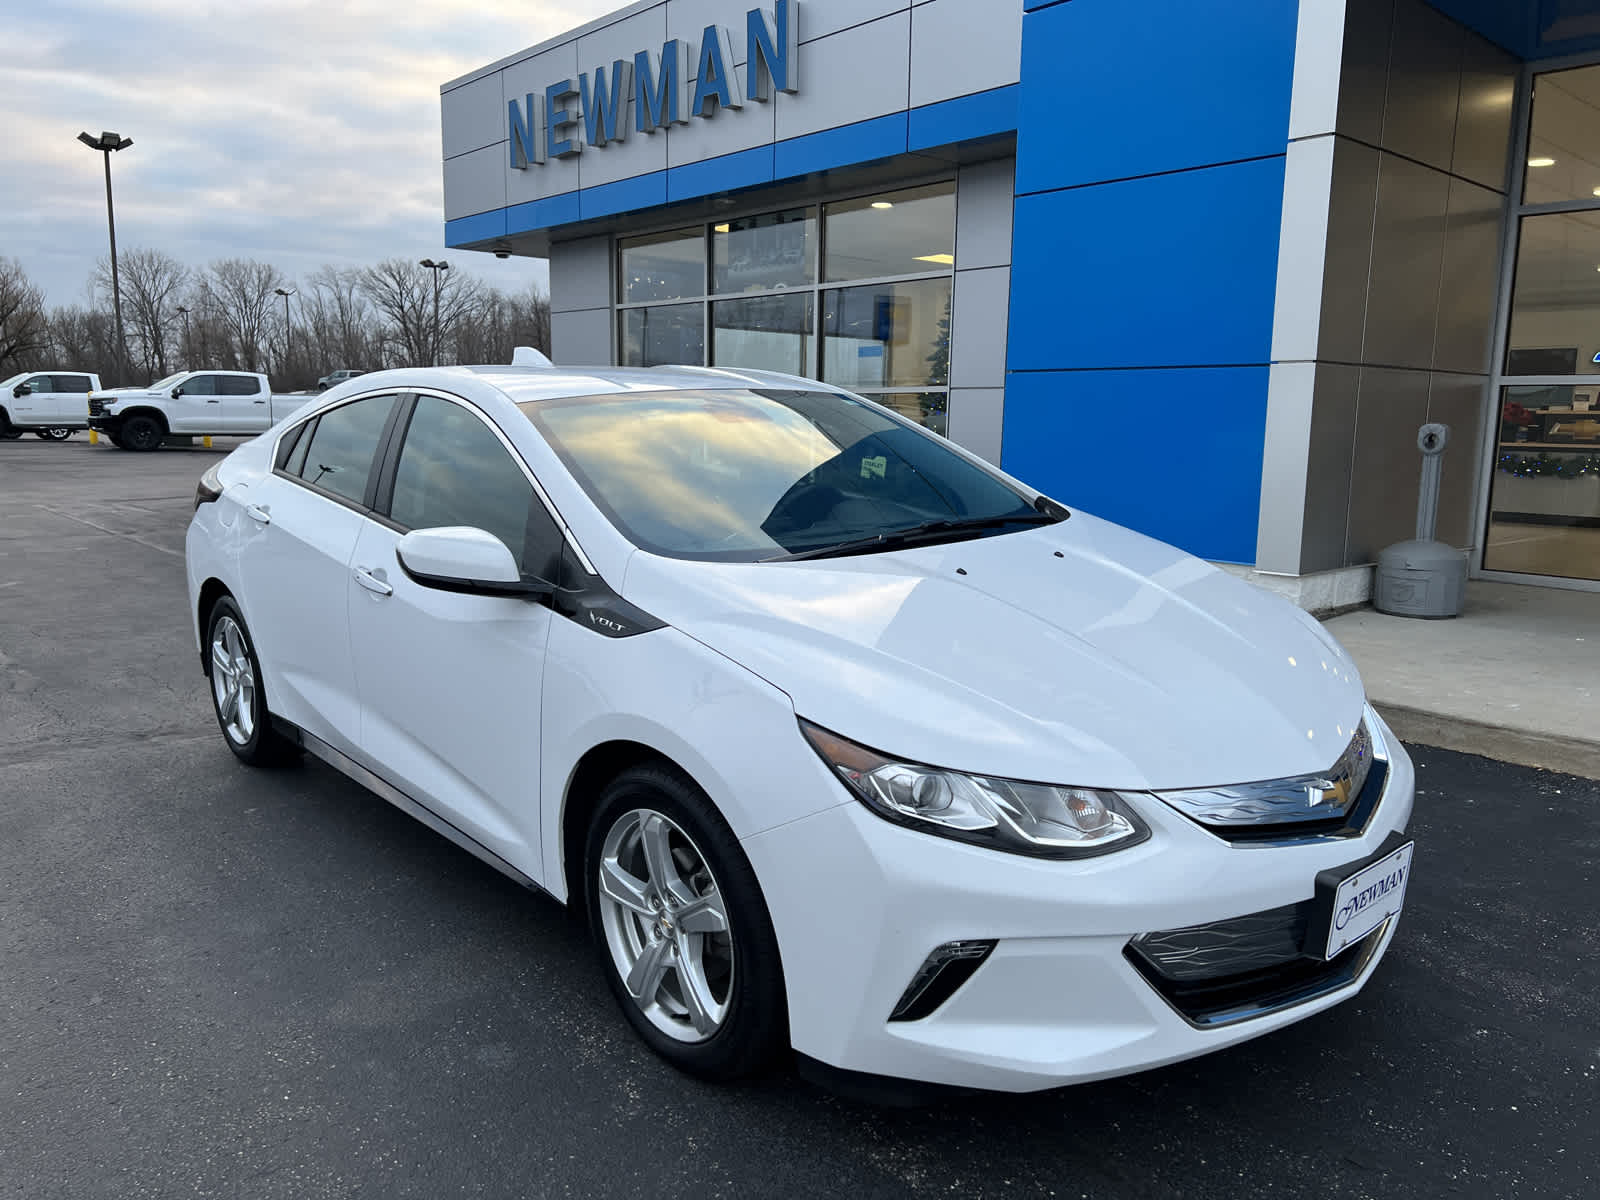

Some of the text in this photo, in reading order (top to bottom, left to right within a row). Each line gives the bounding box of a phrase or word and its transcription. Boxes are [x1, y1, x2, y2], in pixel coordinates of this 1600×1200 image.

[508, 0, 799, 169] NEWMAN
[589, 610, 625, 631] VOLT
[1336, 866, 1406, 930] NEWMAN
